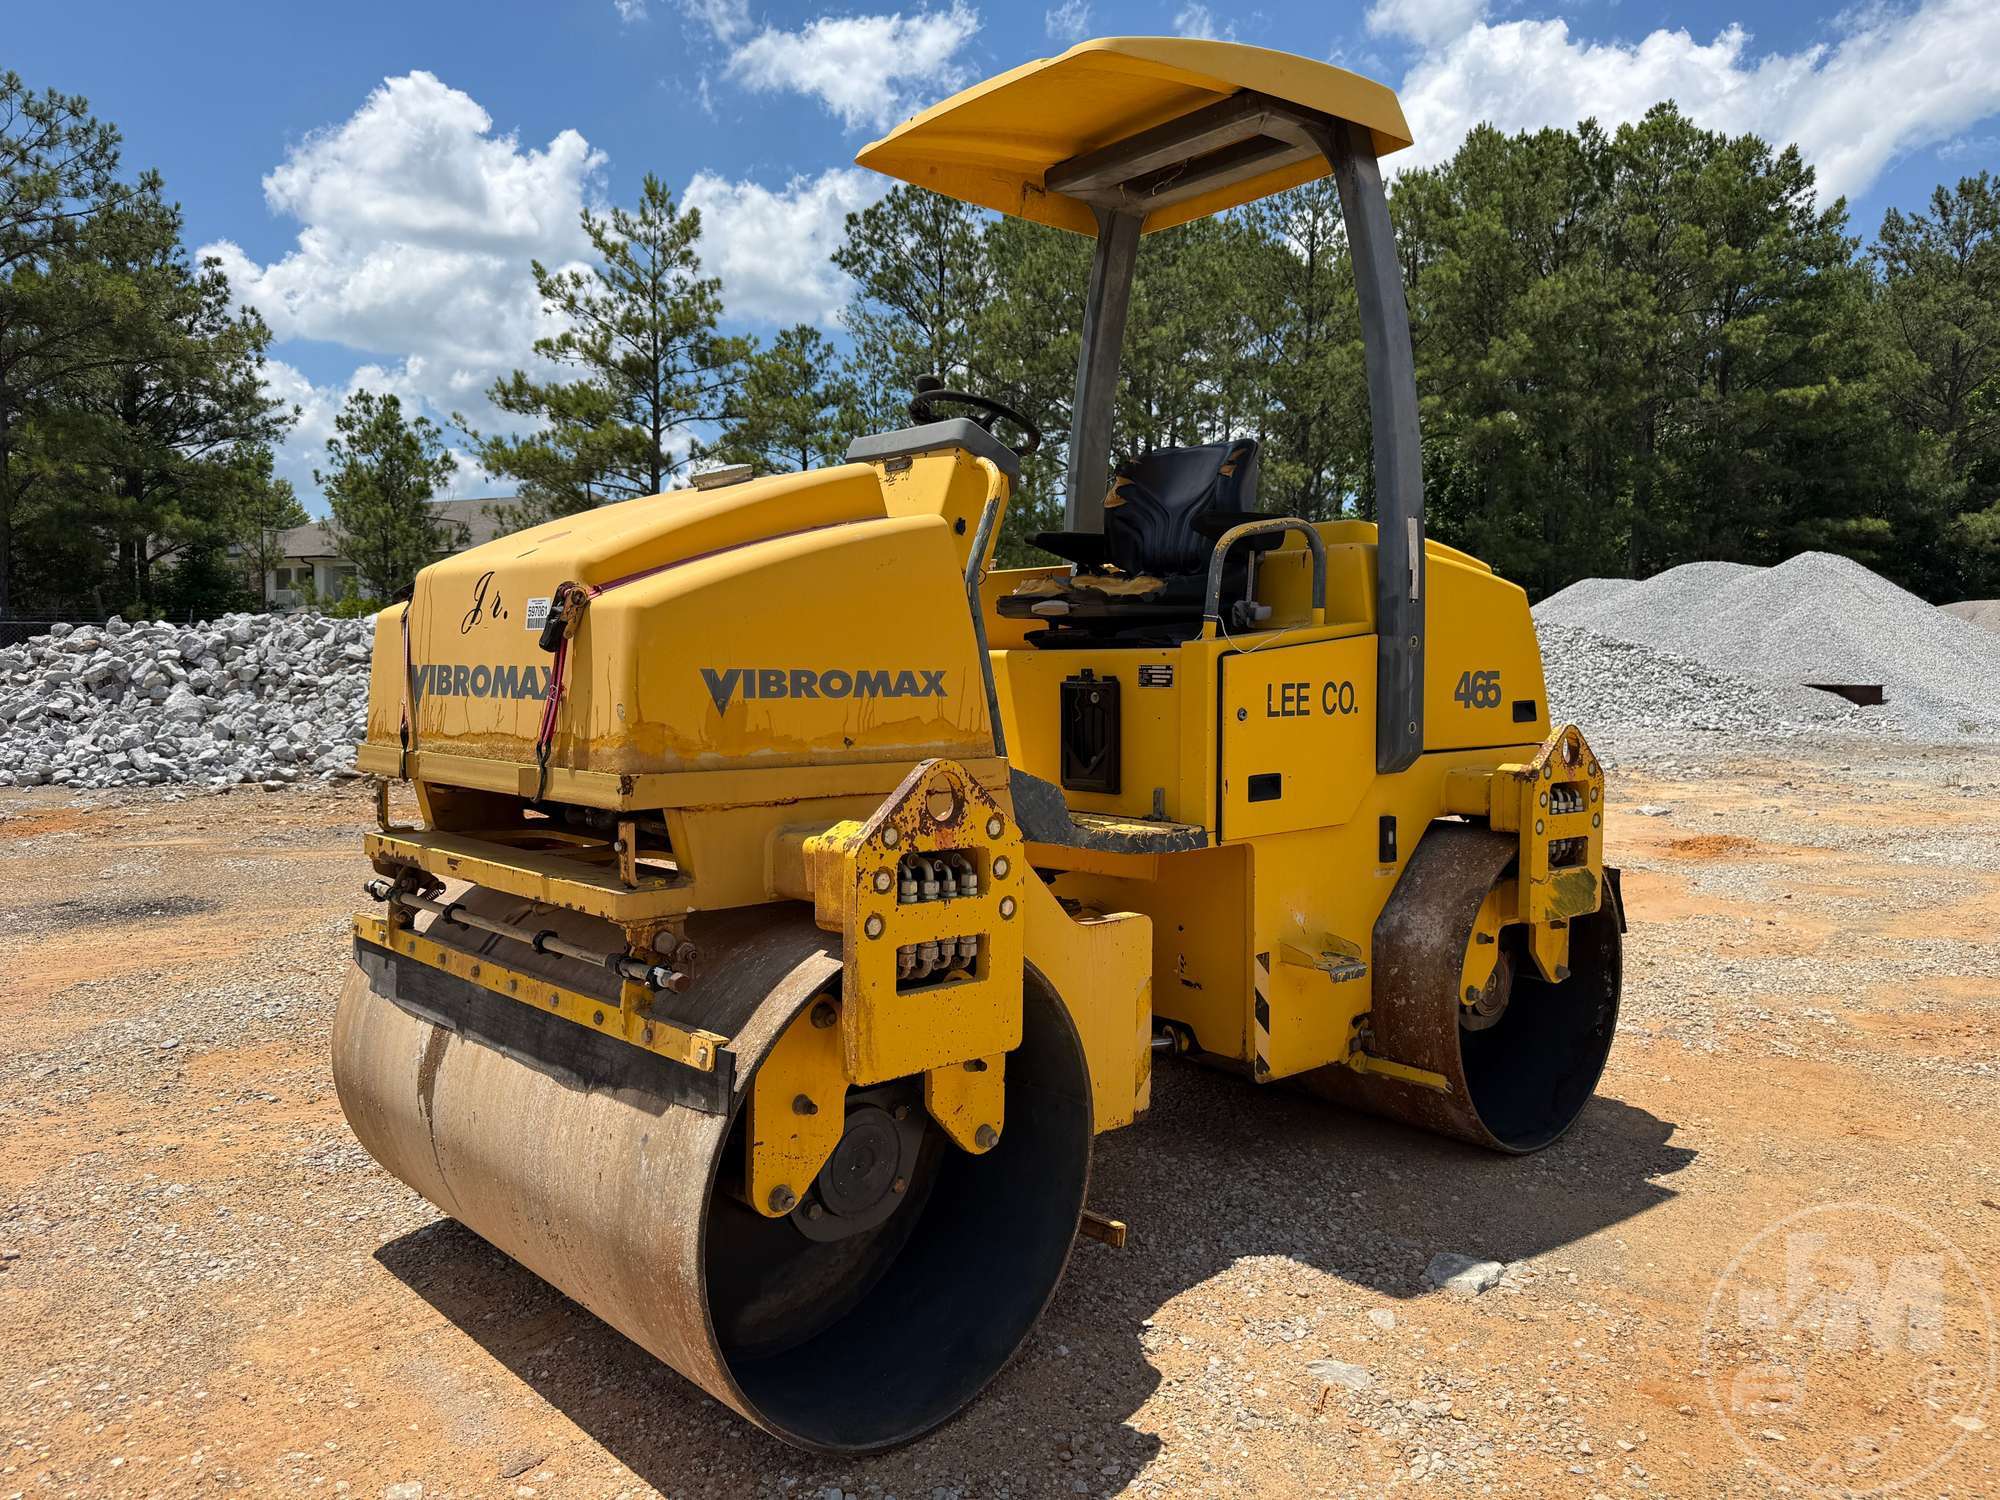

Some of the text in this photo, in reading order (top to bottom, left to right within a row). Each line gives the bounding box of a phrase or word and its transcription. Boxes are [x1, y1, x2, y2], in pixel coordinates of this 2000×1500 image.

[461, 571, 508, 634] Jr.
[700, 668, 948, 718] VIBROMAX
[1267, 680, 1359, 717] LEE CO.
[1455, 671, 1502, 708] 465
